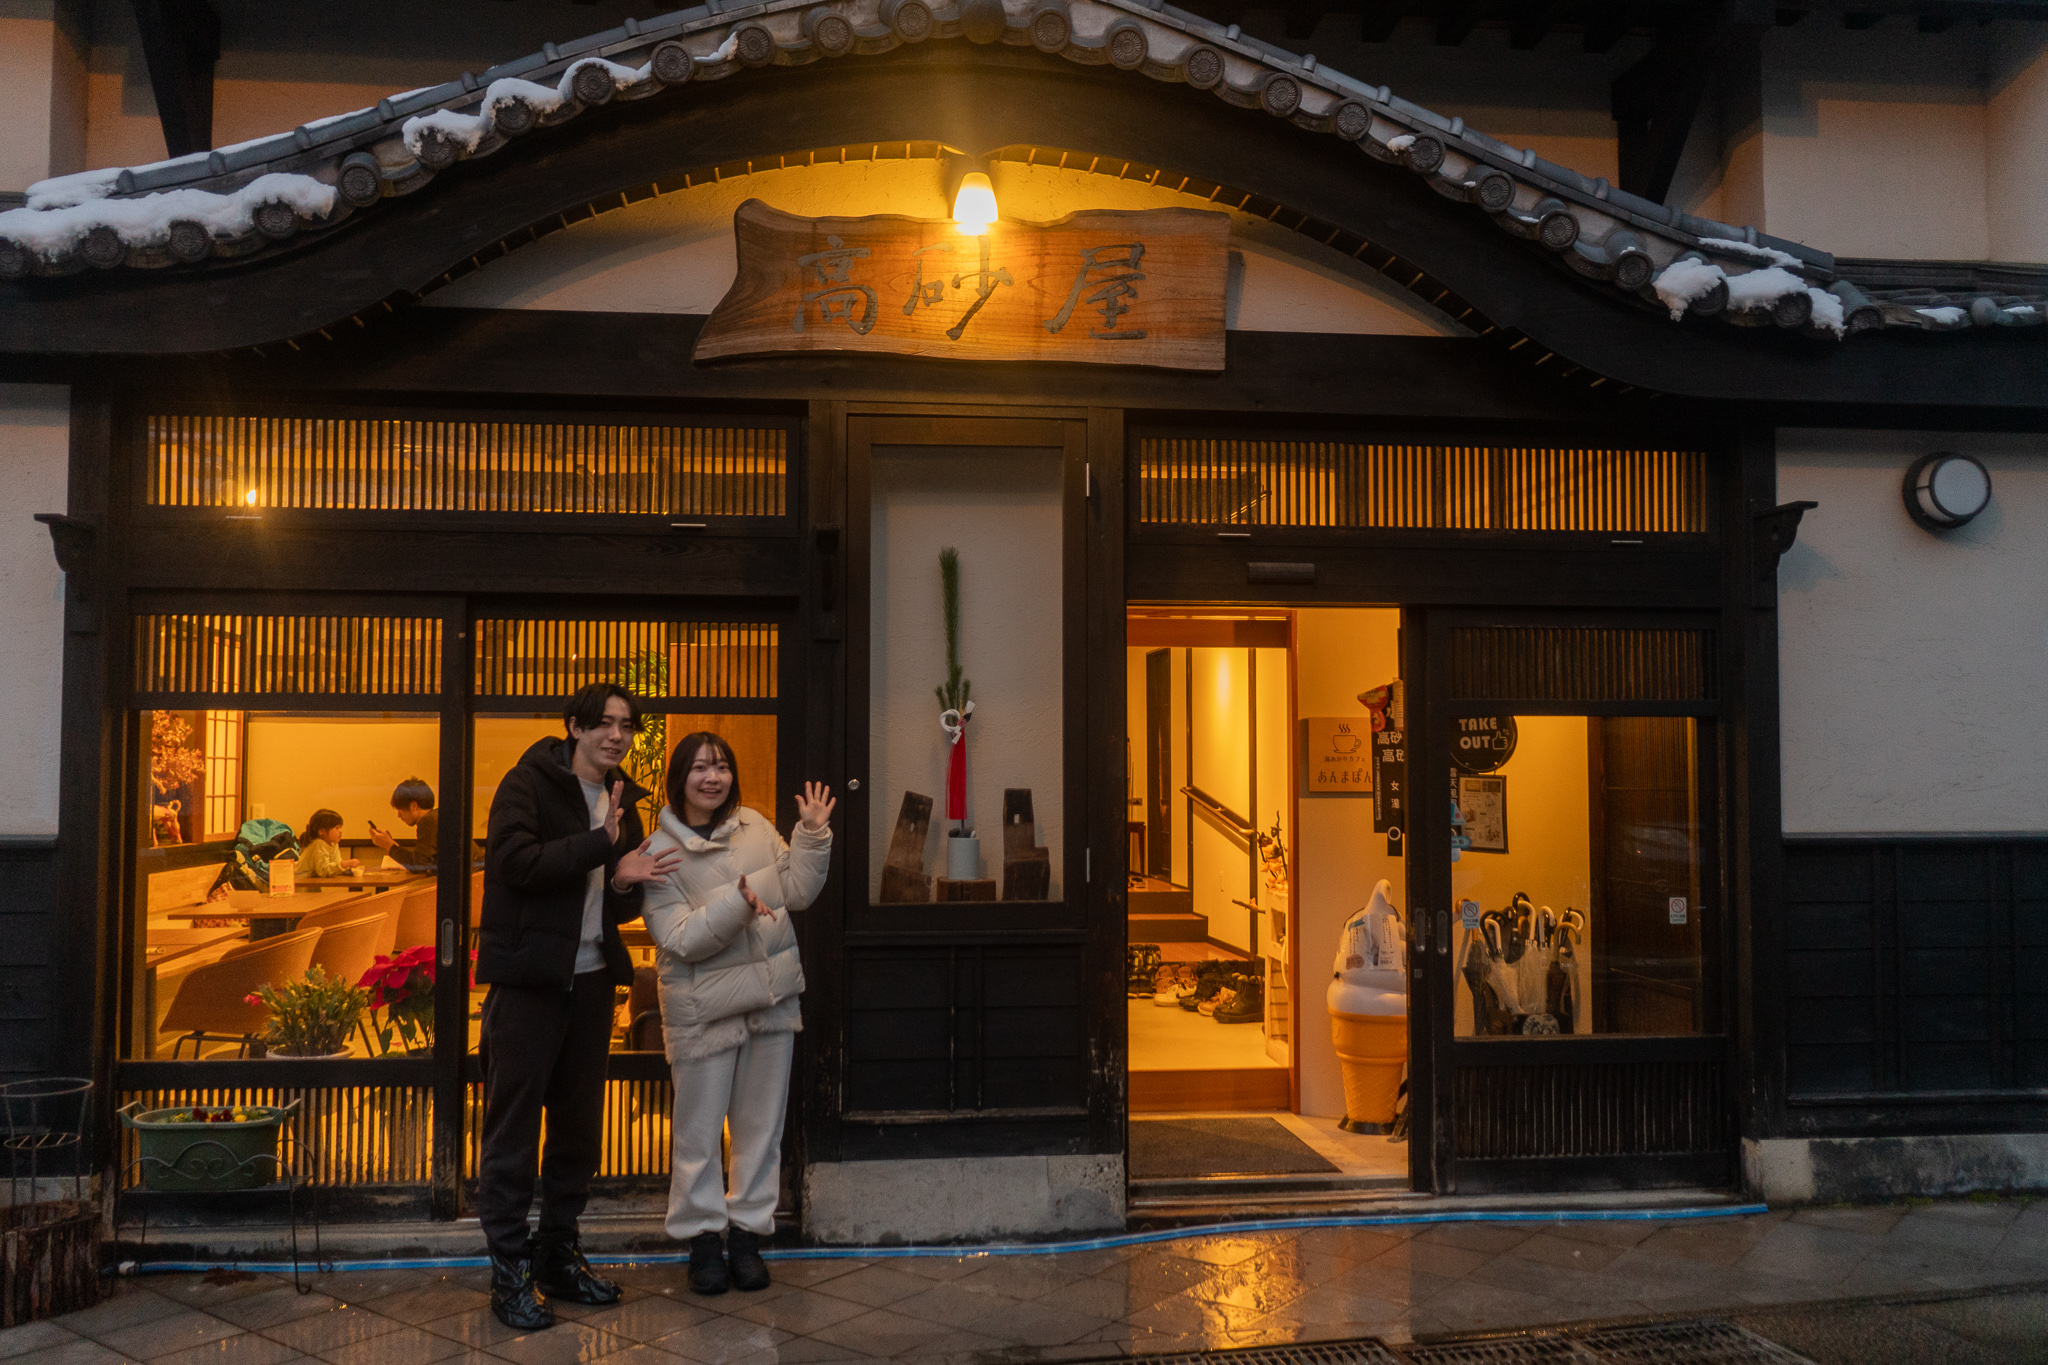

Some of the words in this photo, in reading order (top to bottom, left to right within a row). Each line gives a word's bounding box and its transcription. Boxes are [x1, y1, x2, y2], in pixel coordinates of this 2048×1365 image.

[793, 235, 1147, 341] 高砂屋
[1458, 717, 1497, 731] TAKE
[1460, 736, 1490, 749] OUT
[1317, 768, 1372, 783] あんまぽん
